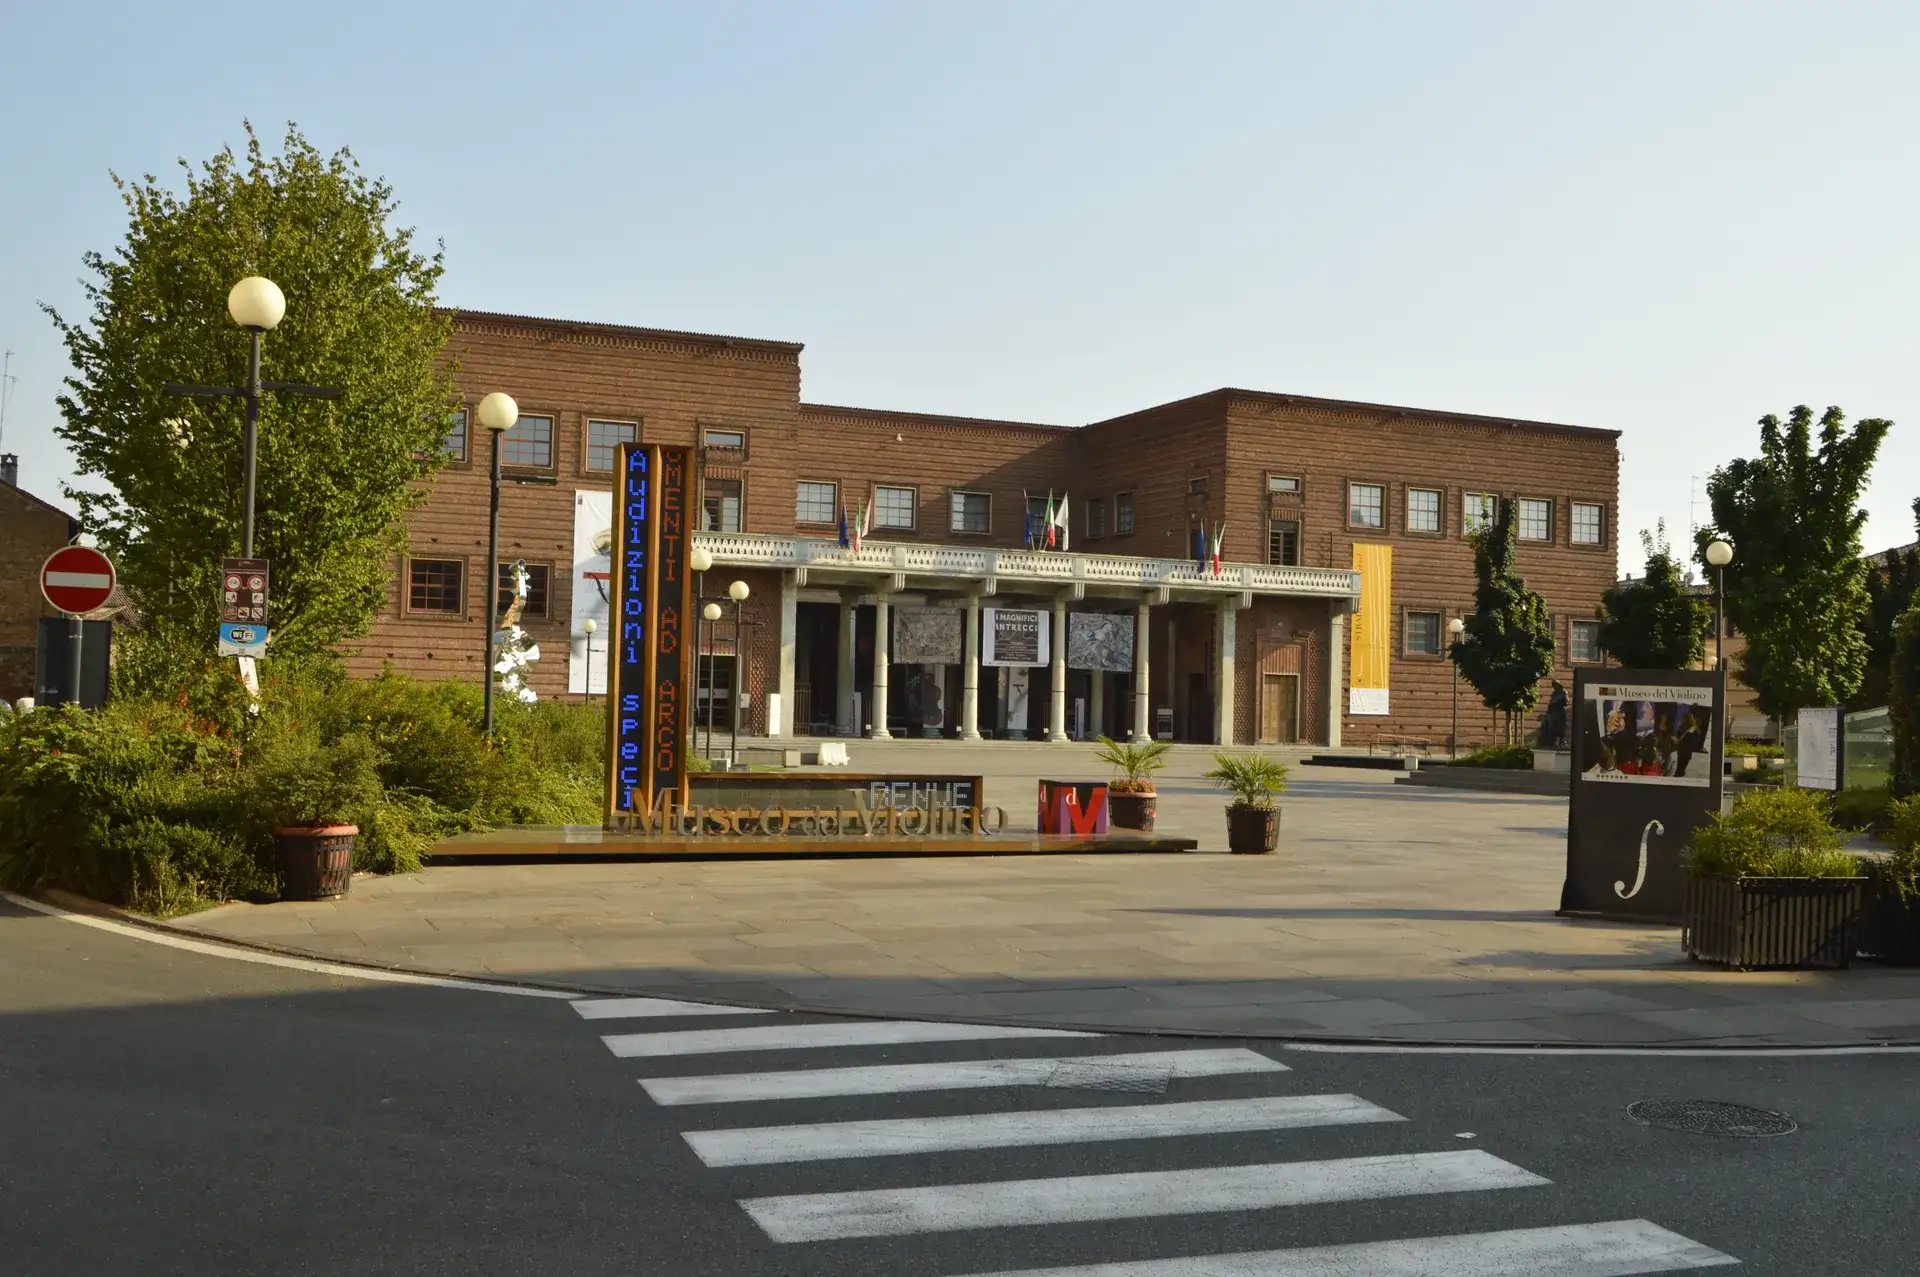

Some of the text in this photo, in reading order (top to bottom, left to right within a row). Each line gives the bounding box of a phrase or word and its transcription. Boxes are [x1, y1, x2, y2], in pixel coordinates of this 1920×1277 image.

[660, 606, 678, 654] AD
[995, 623, 1038, 632] INTRECCI
[999, 613, 1038, 623] MAGNIFICI
[1619, 687, 1707, 700] Museo del Violino
[657, 679, 676, 772] ARCO
[630, 787, 1009, 836] Museo del Violino
